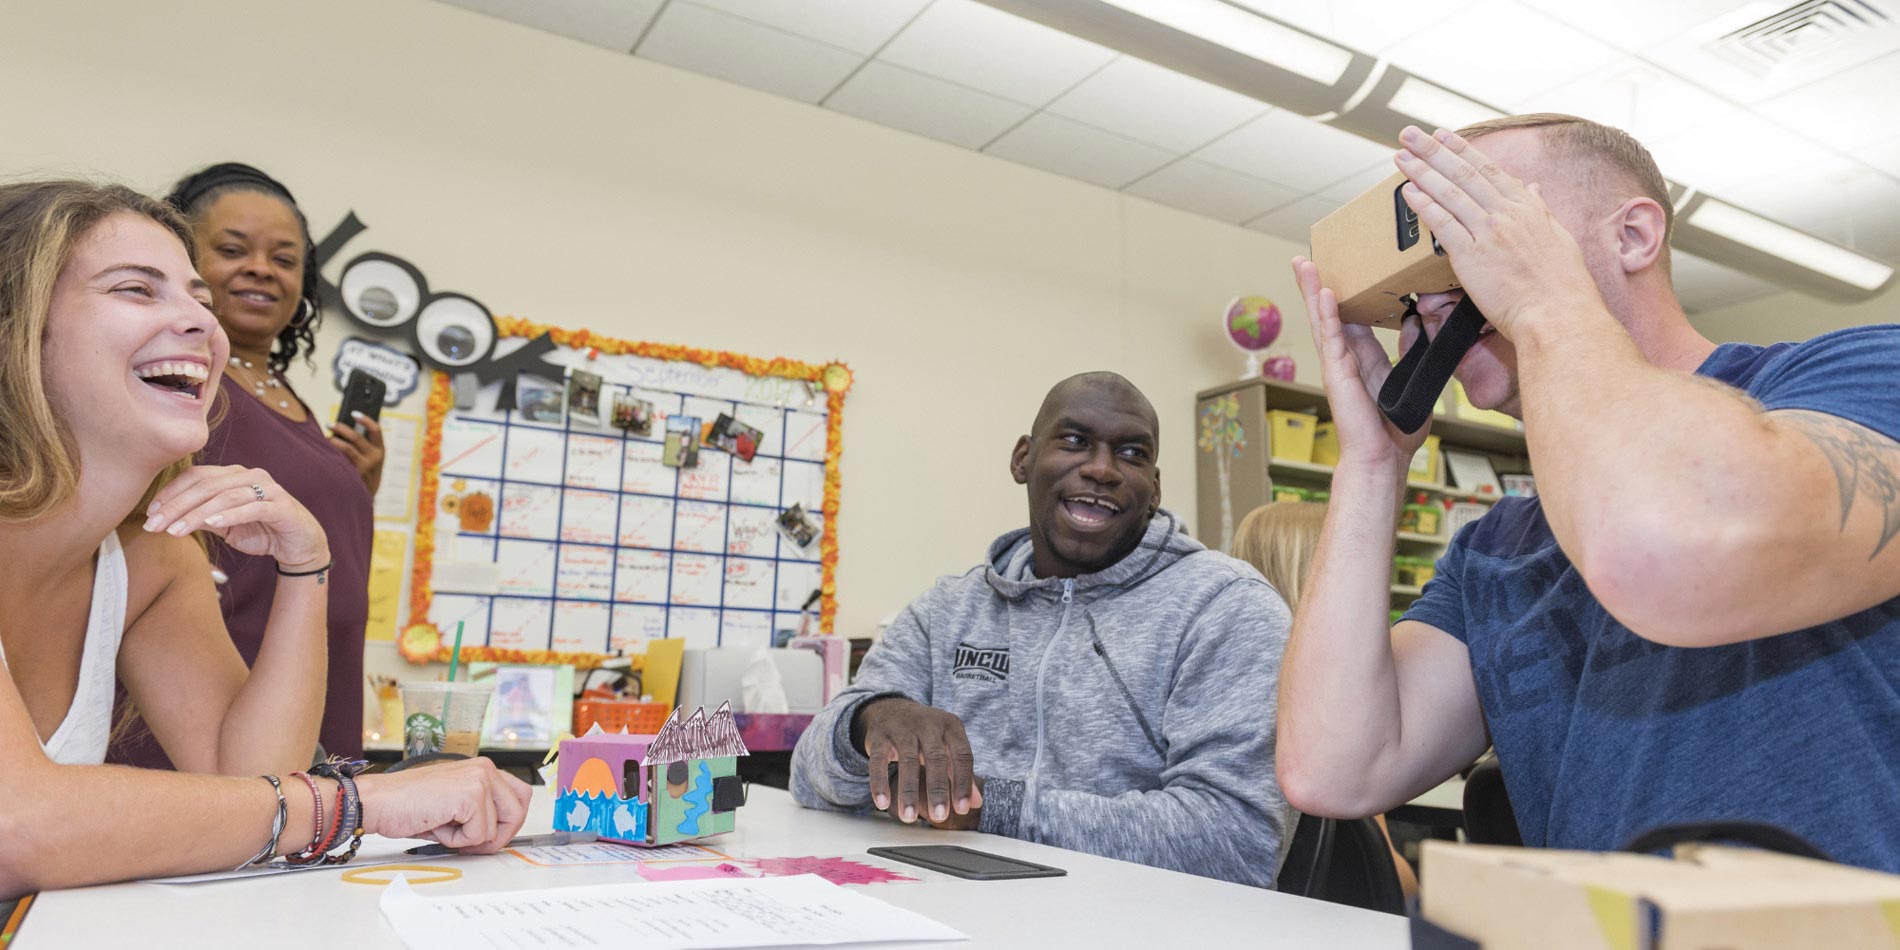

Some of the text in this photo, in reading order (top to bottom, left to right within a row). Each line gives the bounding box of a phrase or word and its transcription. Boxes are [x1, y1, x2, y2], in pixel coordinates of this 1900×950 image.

[627, 362, 722, 388] September
[953, 647, 1009, 674] UNCW
[955, 672, 996, 683] BASKETBALL
